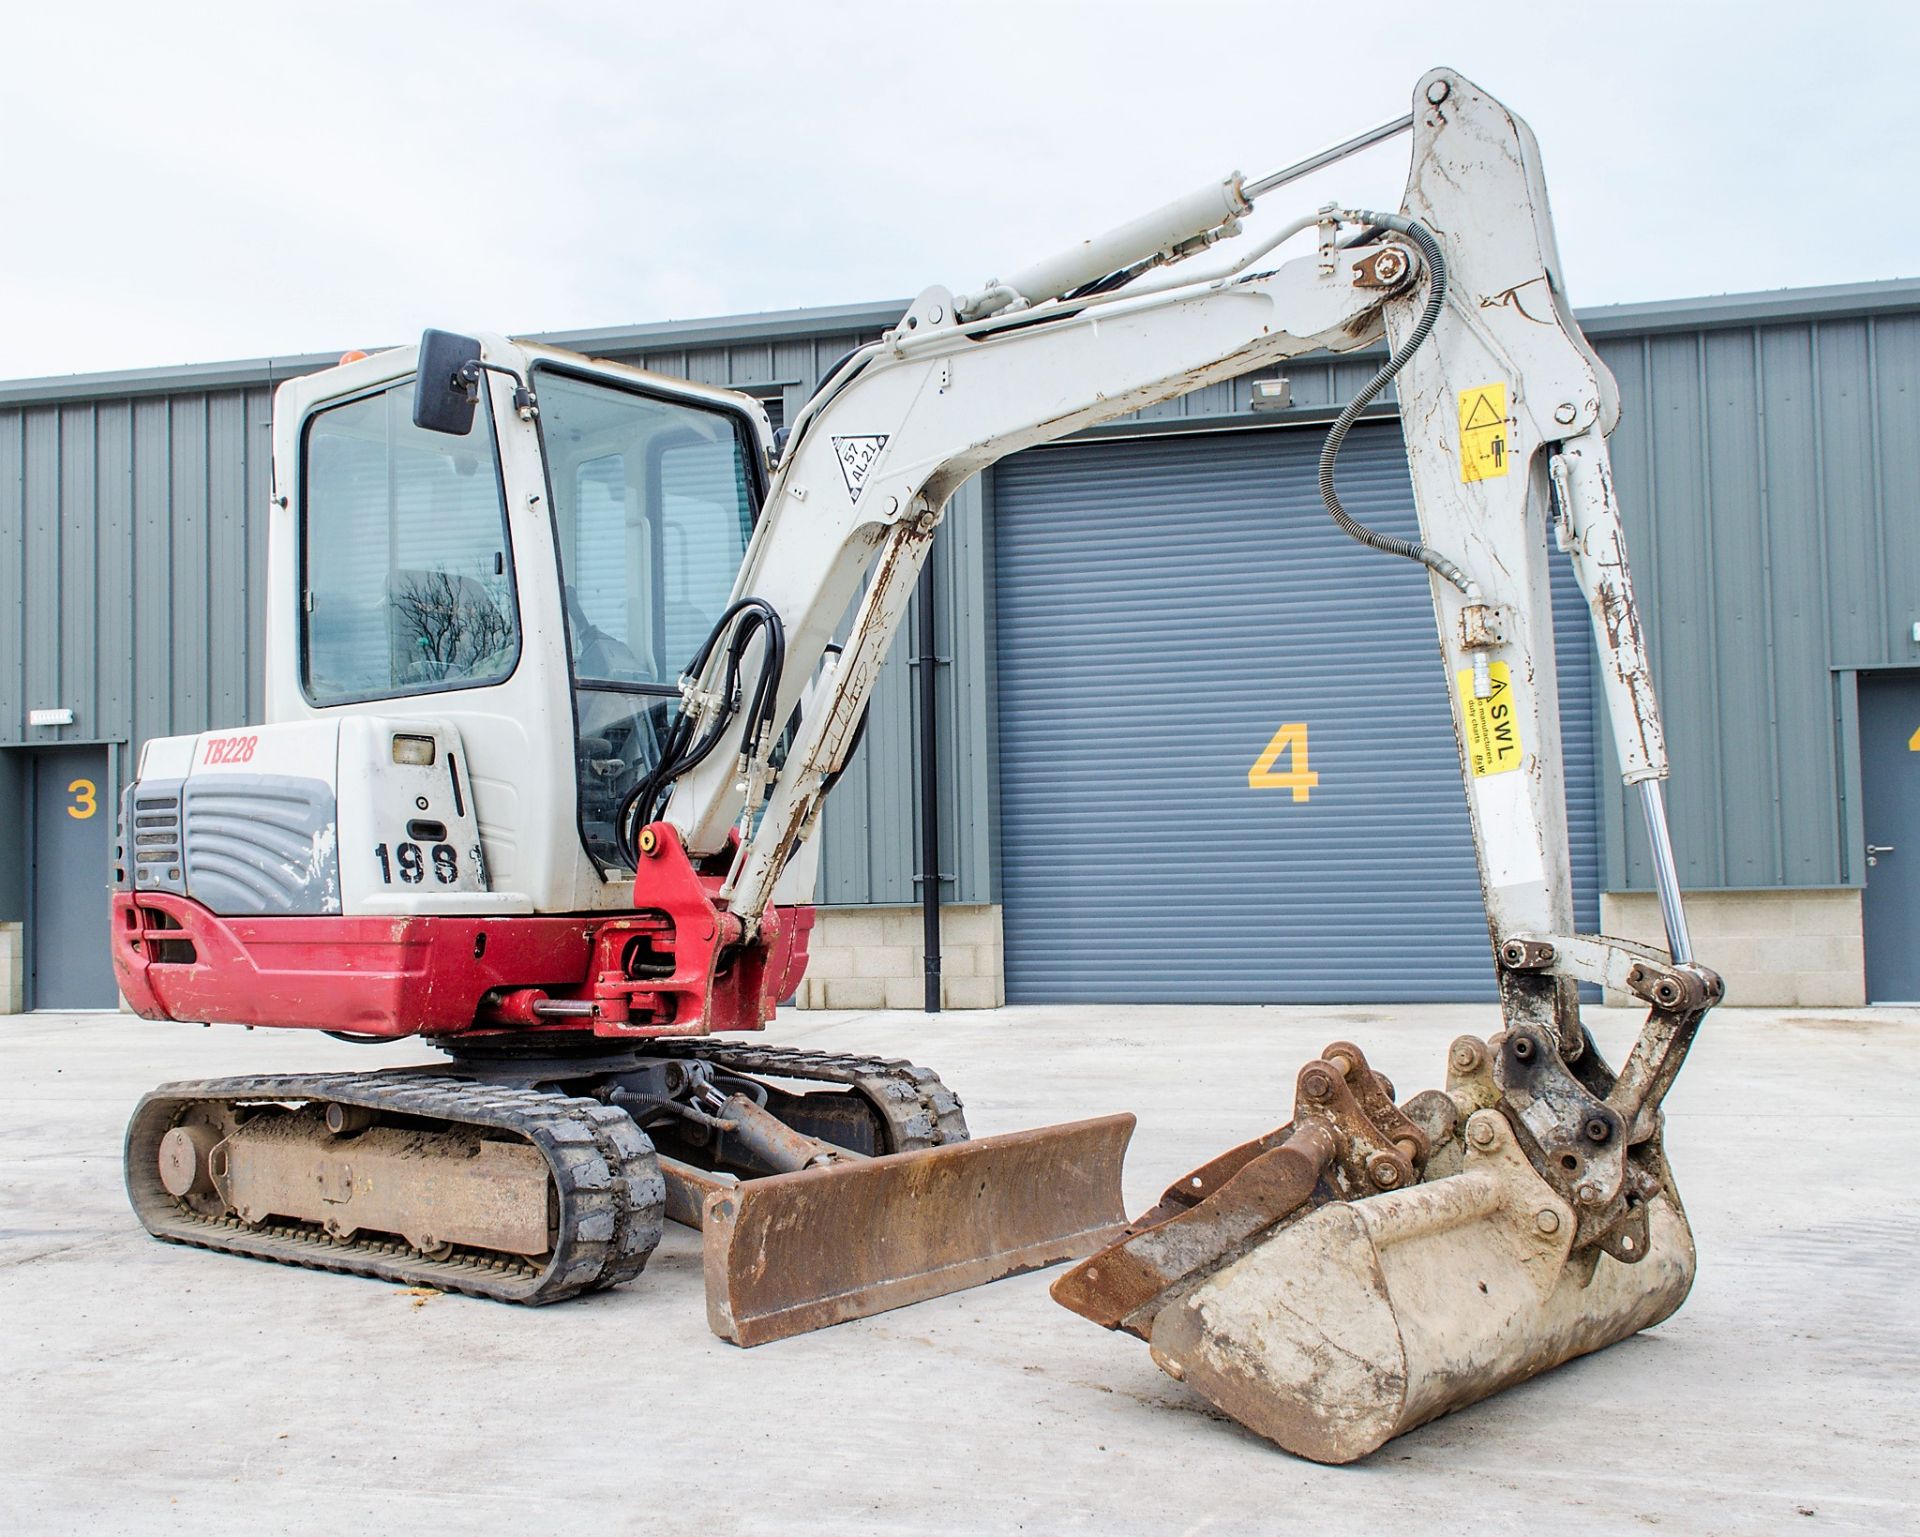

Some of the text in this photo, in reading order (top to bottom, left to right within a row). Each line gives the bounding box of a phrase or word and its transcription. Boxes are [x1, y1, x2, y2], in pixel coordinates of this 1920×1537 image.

[843, 442, 858, 465] 57
[203, 735, 258, 765] TB228
[1479, 707, 1494, 765] manufacturers
[1491, 704, 1514, 761] SWL
[1248, 722, 1320, 802] 4
[67, 778, 97, 820] 3
